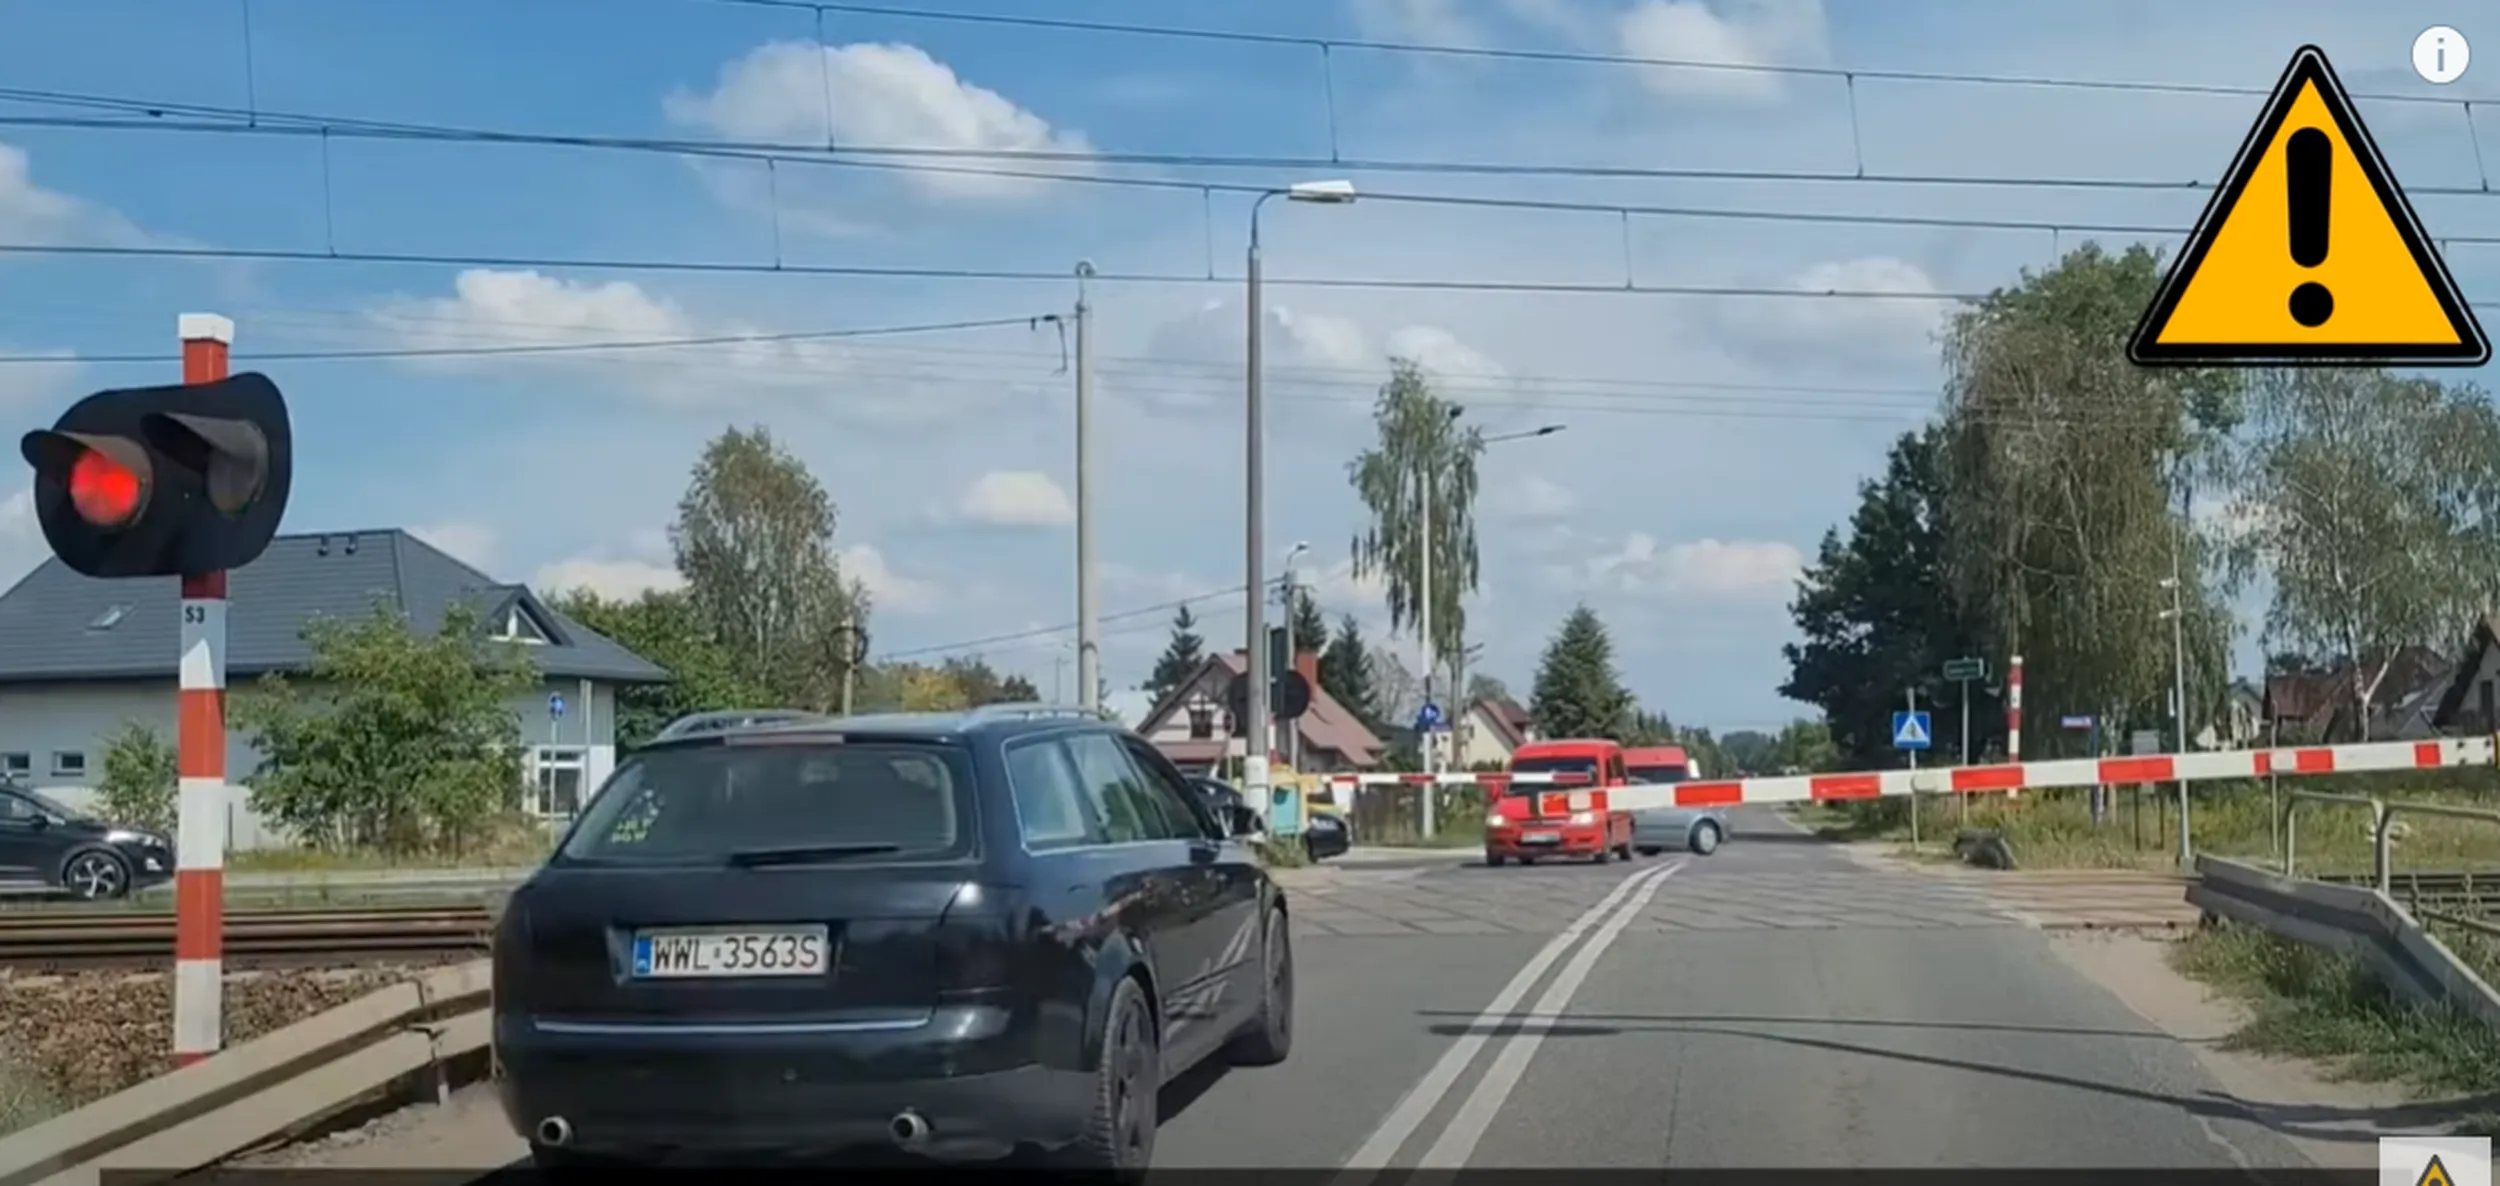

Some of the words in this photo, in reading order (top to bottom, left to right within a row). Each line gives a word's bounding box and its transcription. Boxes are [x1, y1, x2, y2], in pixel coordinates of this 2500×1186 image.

[185, 605, 205, 624] S3
[655, 938, 709, 970] WWL
[723, 936, 818, 969] 3563S
